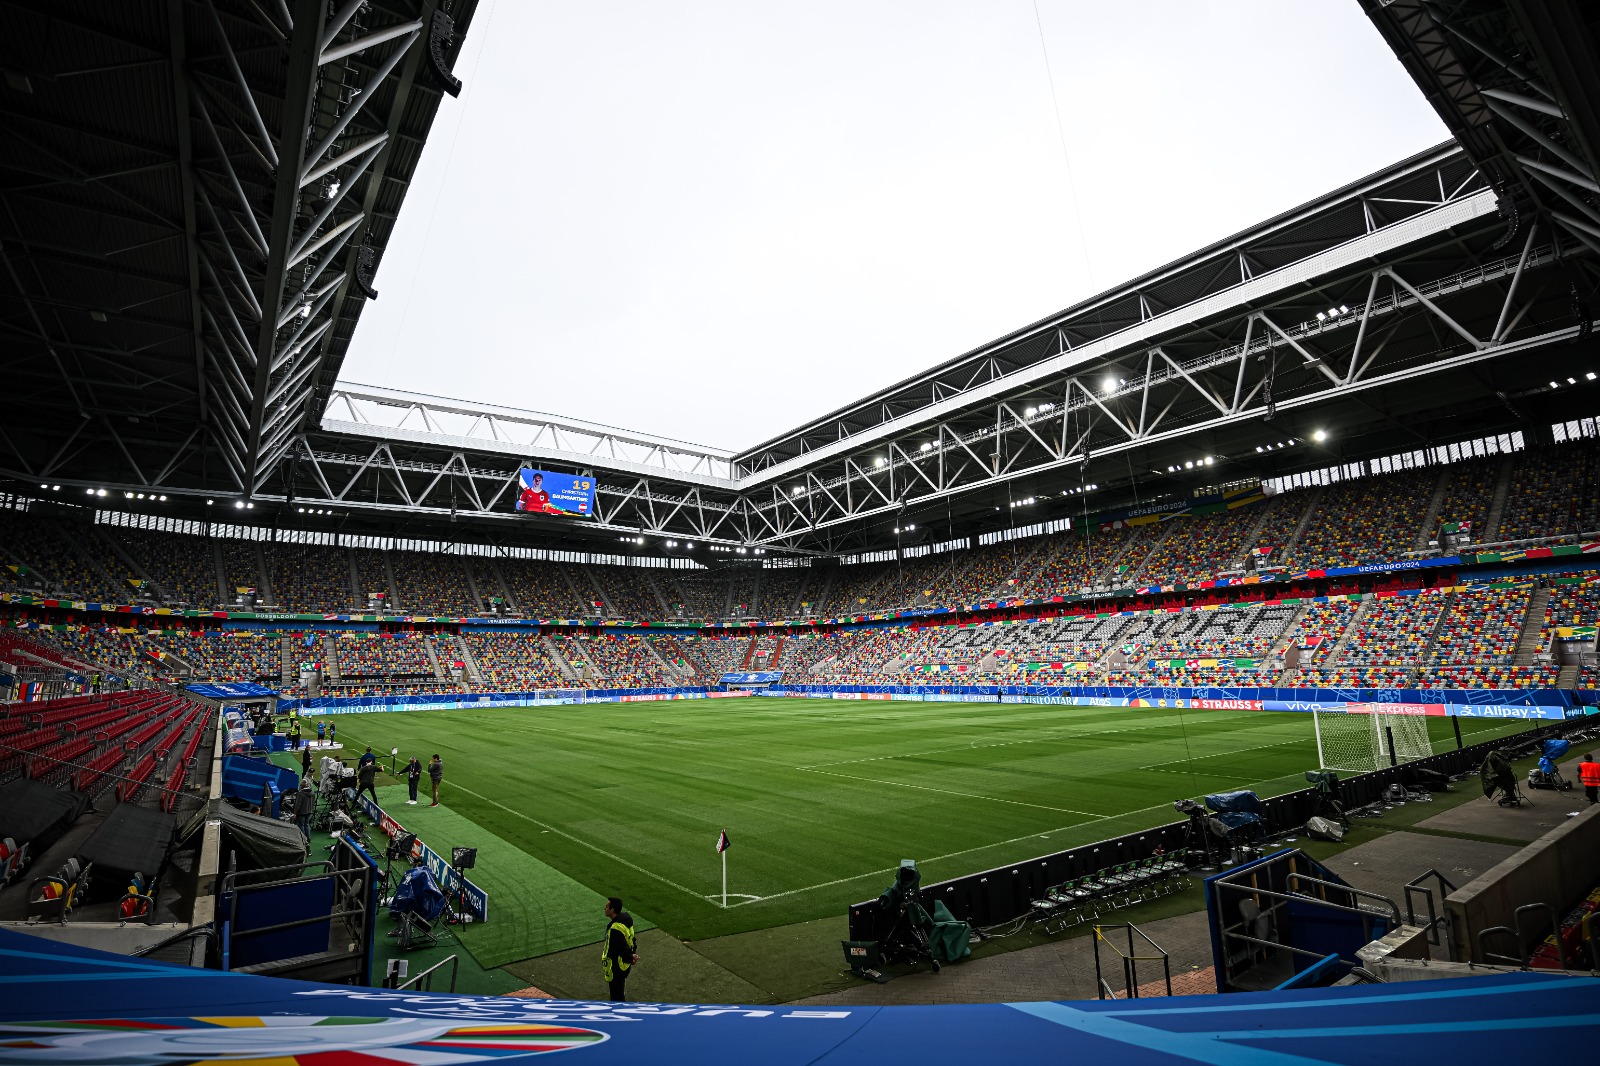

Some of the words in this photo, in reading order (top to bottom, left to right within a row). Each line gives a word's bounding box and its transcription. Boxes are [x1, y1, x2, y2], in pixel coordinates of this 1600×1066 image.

[573, 480, 590, 490] 19
[332, 704, 387, 714] visitQATAR
[403, 703, 447, 712] Hisense
[1202, 700, 1252, 709] STRAUSS
[1285, 700, 1321, 711] vivo
